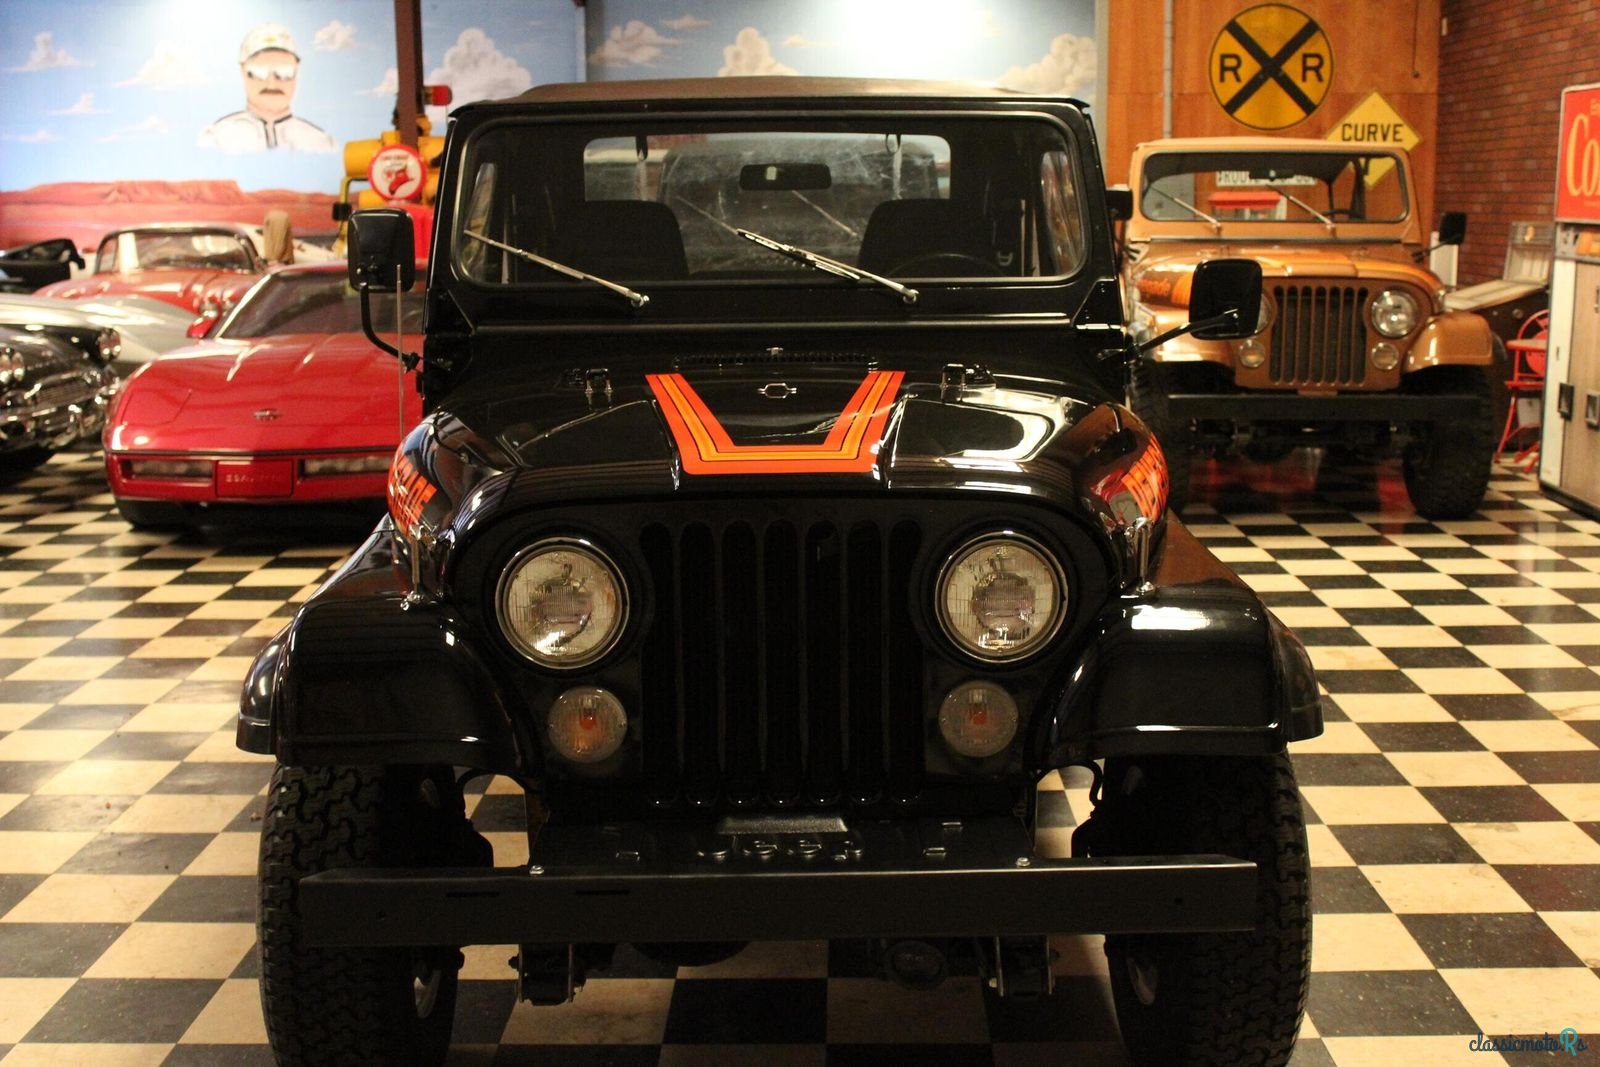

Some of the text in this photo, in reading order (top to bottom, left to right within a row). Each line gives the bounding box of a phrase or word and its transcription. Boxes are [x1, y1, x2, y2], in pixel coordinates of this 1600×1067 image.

[1219, 53, 1324, 83] R R
[1341, 123, 1404, 142] CURVE
